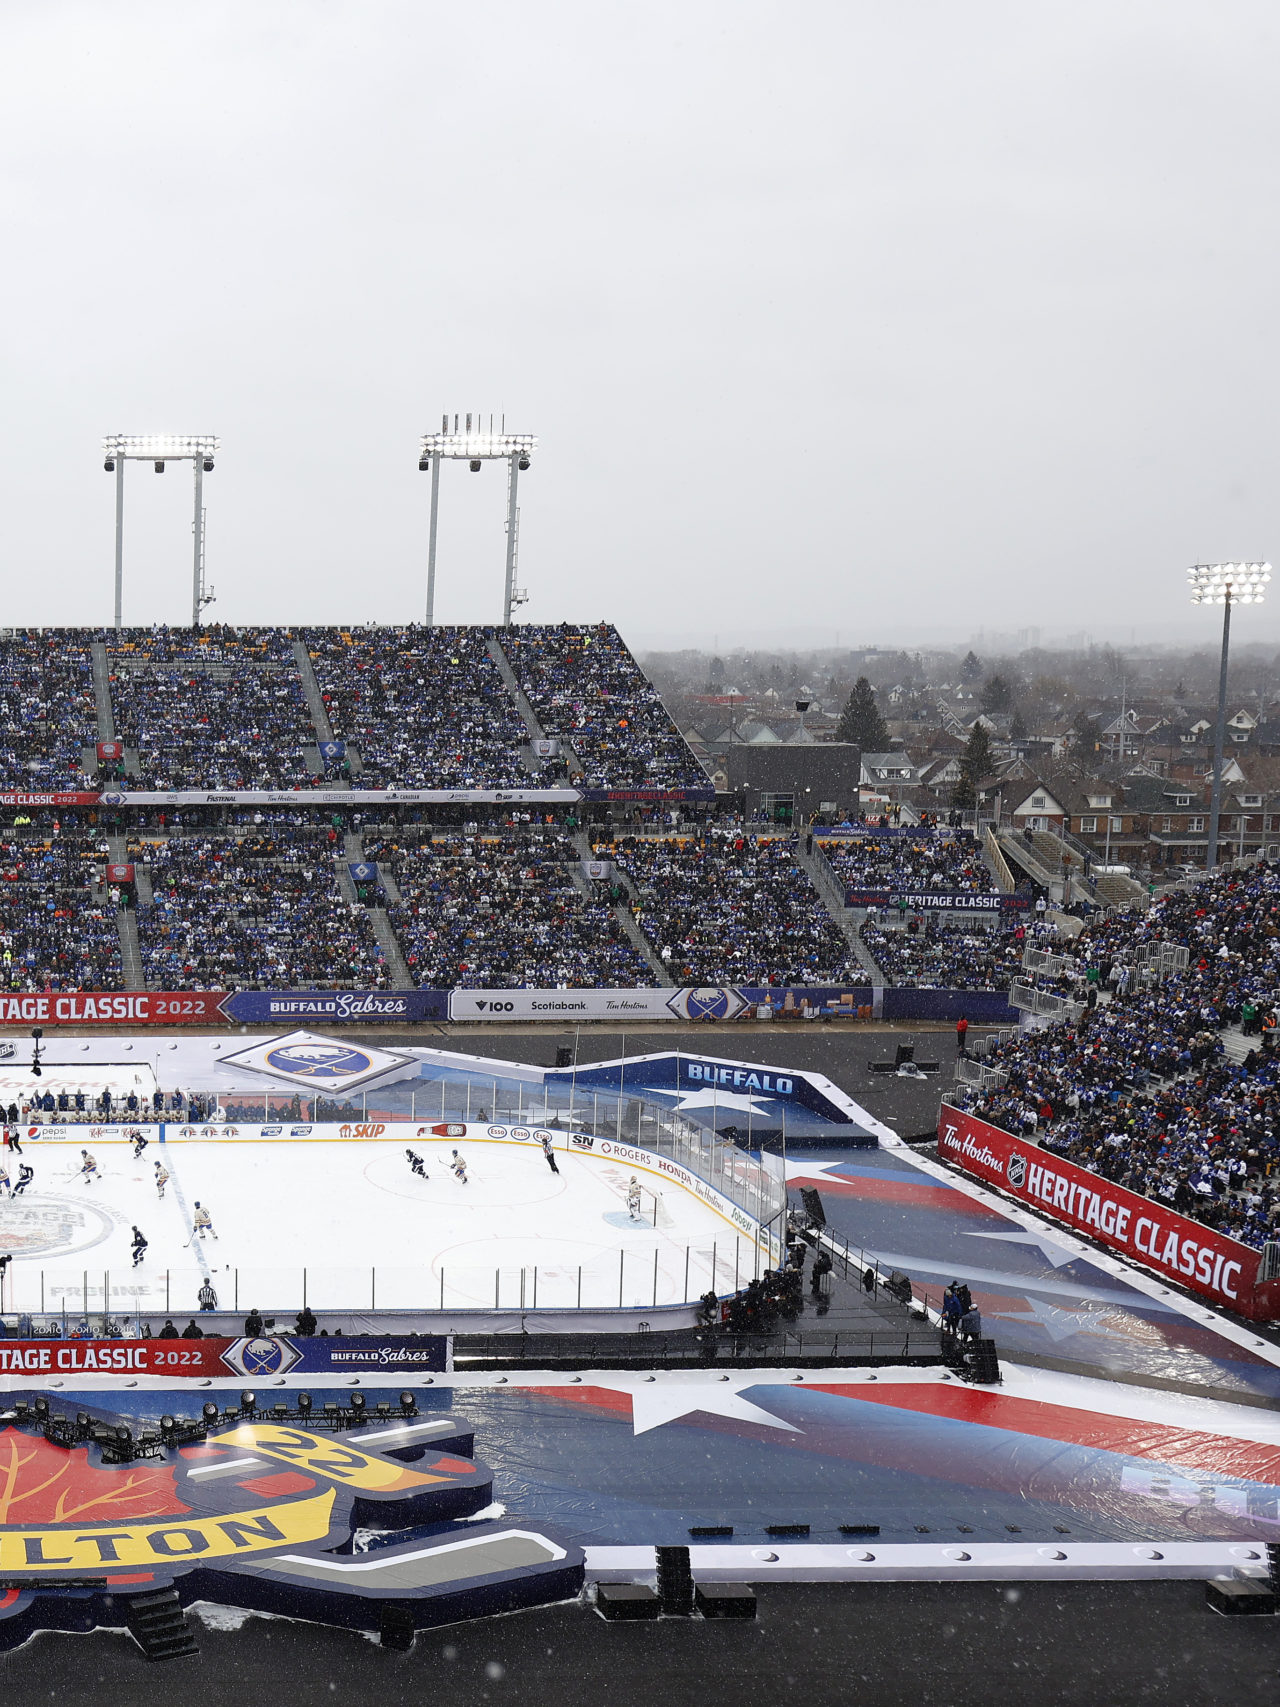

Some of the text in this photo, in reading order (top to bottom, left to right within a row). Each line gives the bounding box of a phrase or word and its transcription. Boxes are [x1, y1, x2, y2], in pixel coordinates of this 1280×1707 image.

[17, 795, 55, 804] CLASSIC
[56, 796, 77, 804] 2022
[206, 795, 237, 803] FASTENAL
[955, 897, 1001, 908] CLASSIC
[56, 997, 149, 1019] CLASSIC
[155, 1000, 206, 1015] 2022
[270, 1002, 336, 1012] BUFFALO
[336, 994, 407, 1017] Sabres
[489, 1002, 514, 1012] 100
[531, 1001, 587, 1011] Scotiabank
[606, 1000, 649, 1010] Tim Hortons
[688, 1063, 793, 1095] BUFFALO
[42, 1128, 66, 1138] pepsi
[352, 1124, 386, 1138] SKIP
[513, 1130, 528, 1138] Esso
[535, 1131, 550, 1140] Esso
[572, 1134, 594, 1146] SN
[613, 1146, 651, 1165] ROGERS
[943, 1124, 1004, 1174] Tim Hortons
[658, 1160, 692, 1186] HONDA
[732, 1206, 752, 1231] Sobeys
[1027, 1162, 1243, 1300] HERITAGE CLASSIC
[57, 1348, 148, 1368] CLASSIC
[153, 1351, 204, 1365] 2022
[331, 1347, 430, 1364] BUFFALO Sabres
